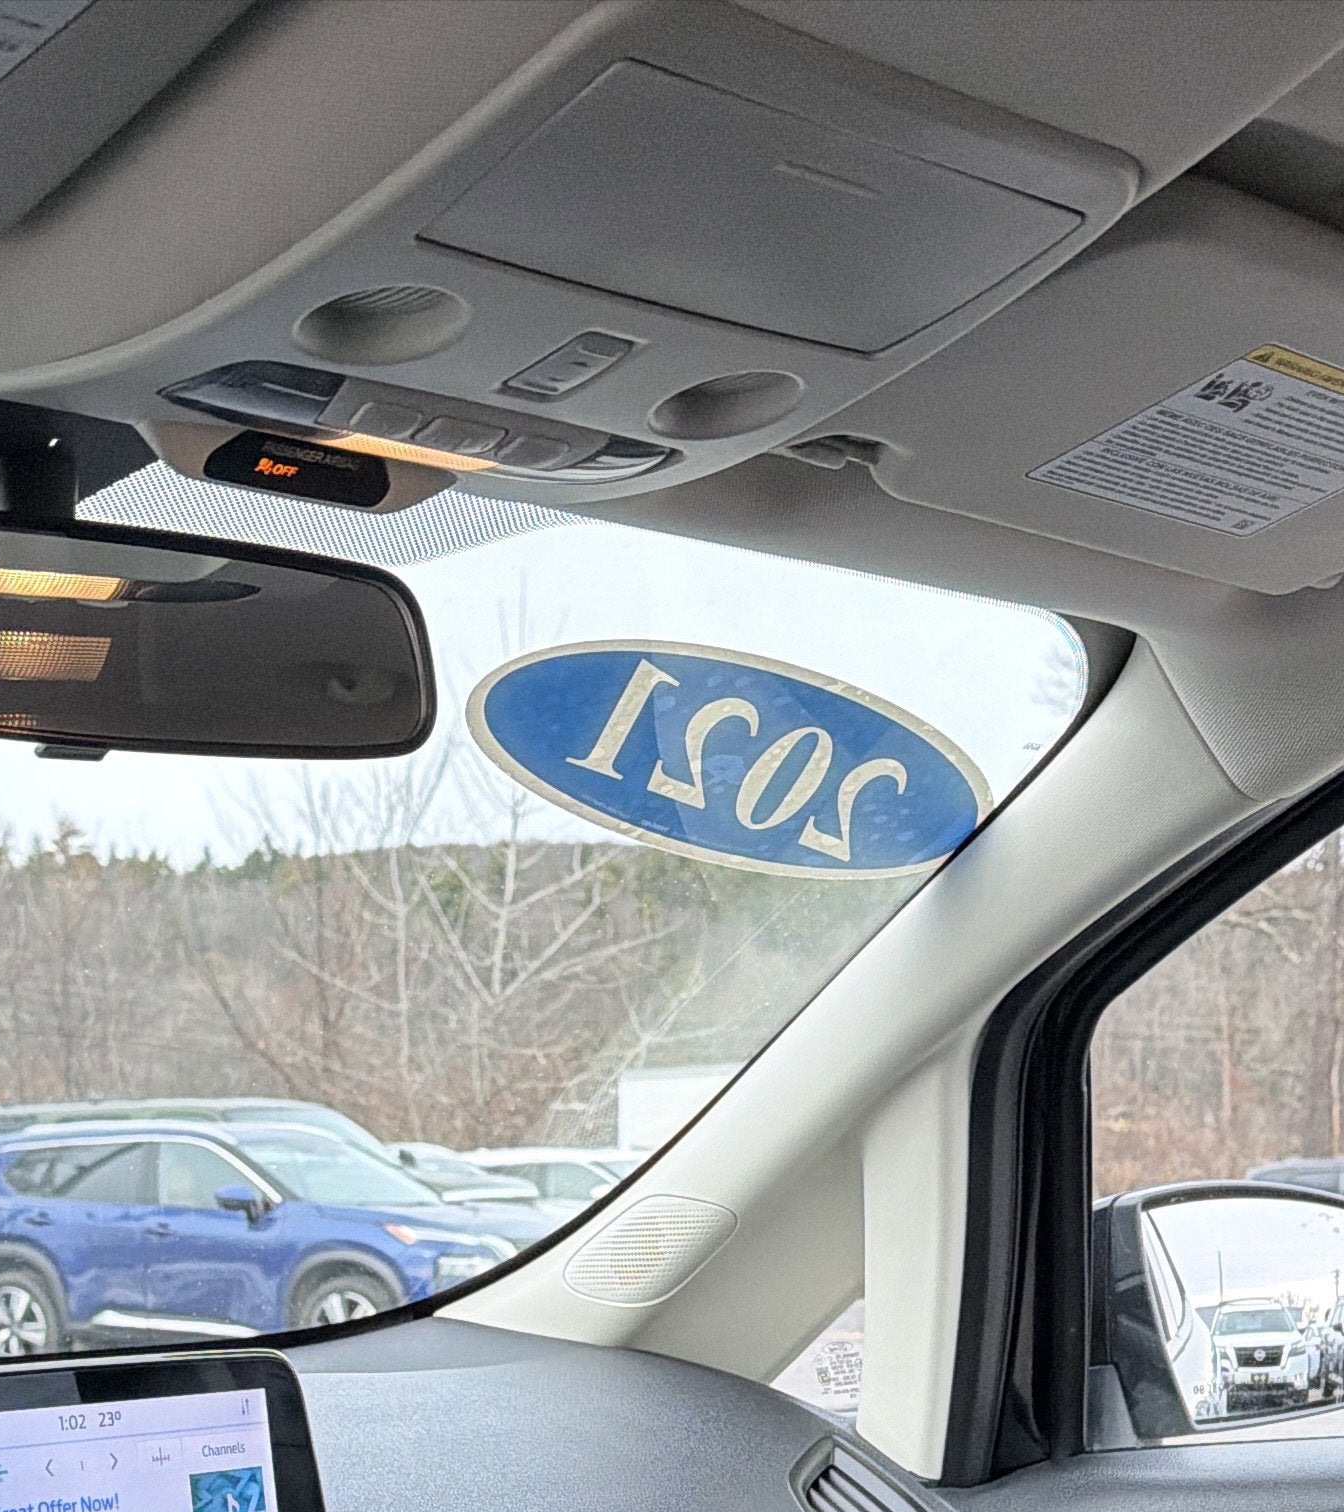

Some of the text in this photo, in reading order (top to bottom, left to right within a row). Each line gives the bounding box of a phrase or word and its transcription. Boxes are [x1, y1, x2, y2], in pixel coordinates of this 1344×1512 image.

[272, 463, 299, 477] OFF
[58, 1414, 87, 1431] 1:02
[202, 1442, 245, 1458] Channels
[81, 1493, 119, 1512] Now!
